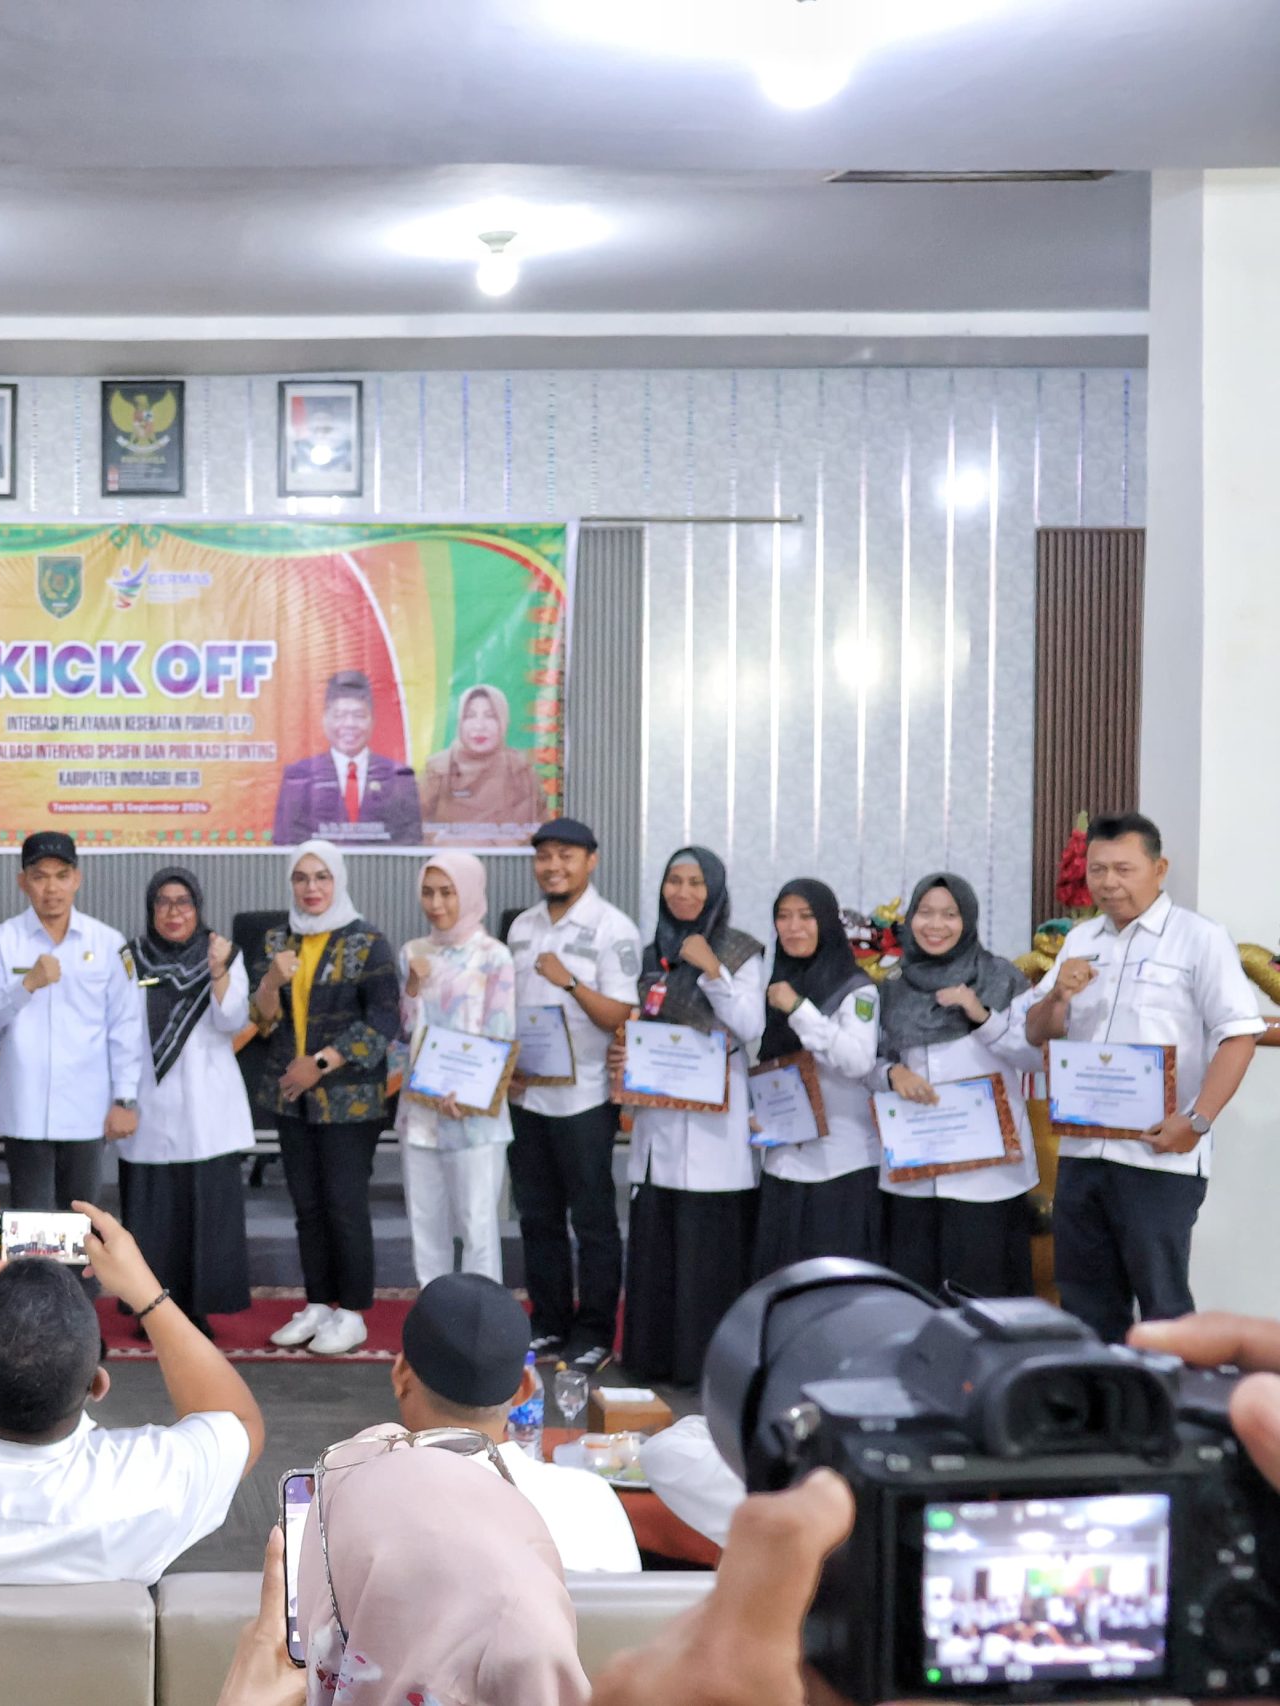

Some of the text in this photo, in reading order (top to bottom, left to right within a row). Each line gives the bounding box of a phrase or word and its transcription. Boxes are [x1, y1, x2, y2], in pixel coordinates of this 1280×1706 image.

[148, 573, 210, 586] GERMAS
[154, 643, 274, 696] OFF
[6, 715, 60, 731] INTEGRASI
[62, 715, 121, 731] PELAYANAN
[124, 715, 182, 731] KESEHATAN
[35, 744, 95, 760] INTERVENSI
[97, 744, 142, 760] SPESIFIK
[144, 744, 166, 760] DAN
[170, 744, 221, 760] PUBLIKASI
[224, 744, 276, 760] STUNTING
[58, 770, 118, 787] KABUPATEN
[126, 801, 181, 815] September
